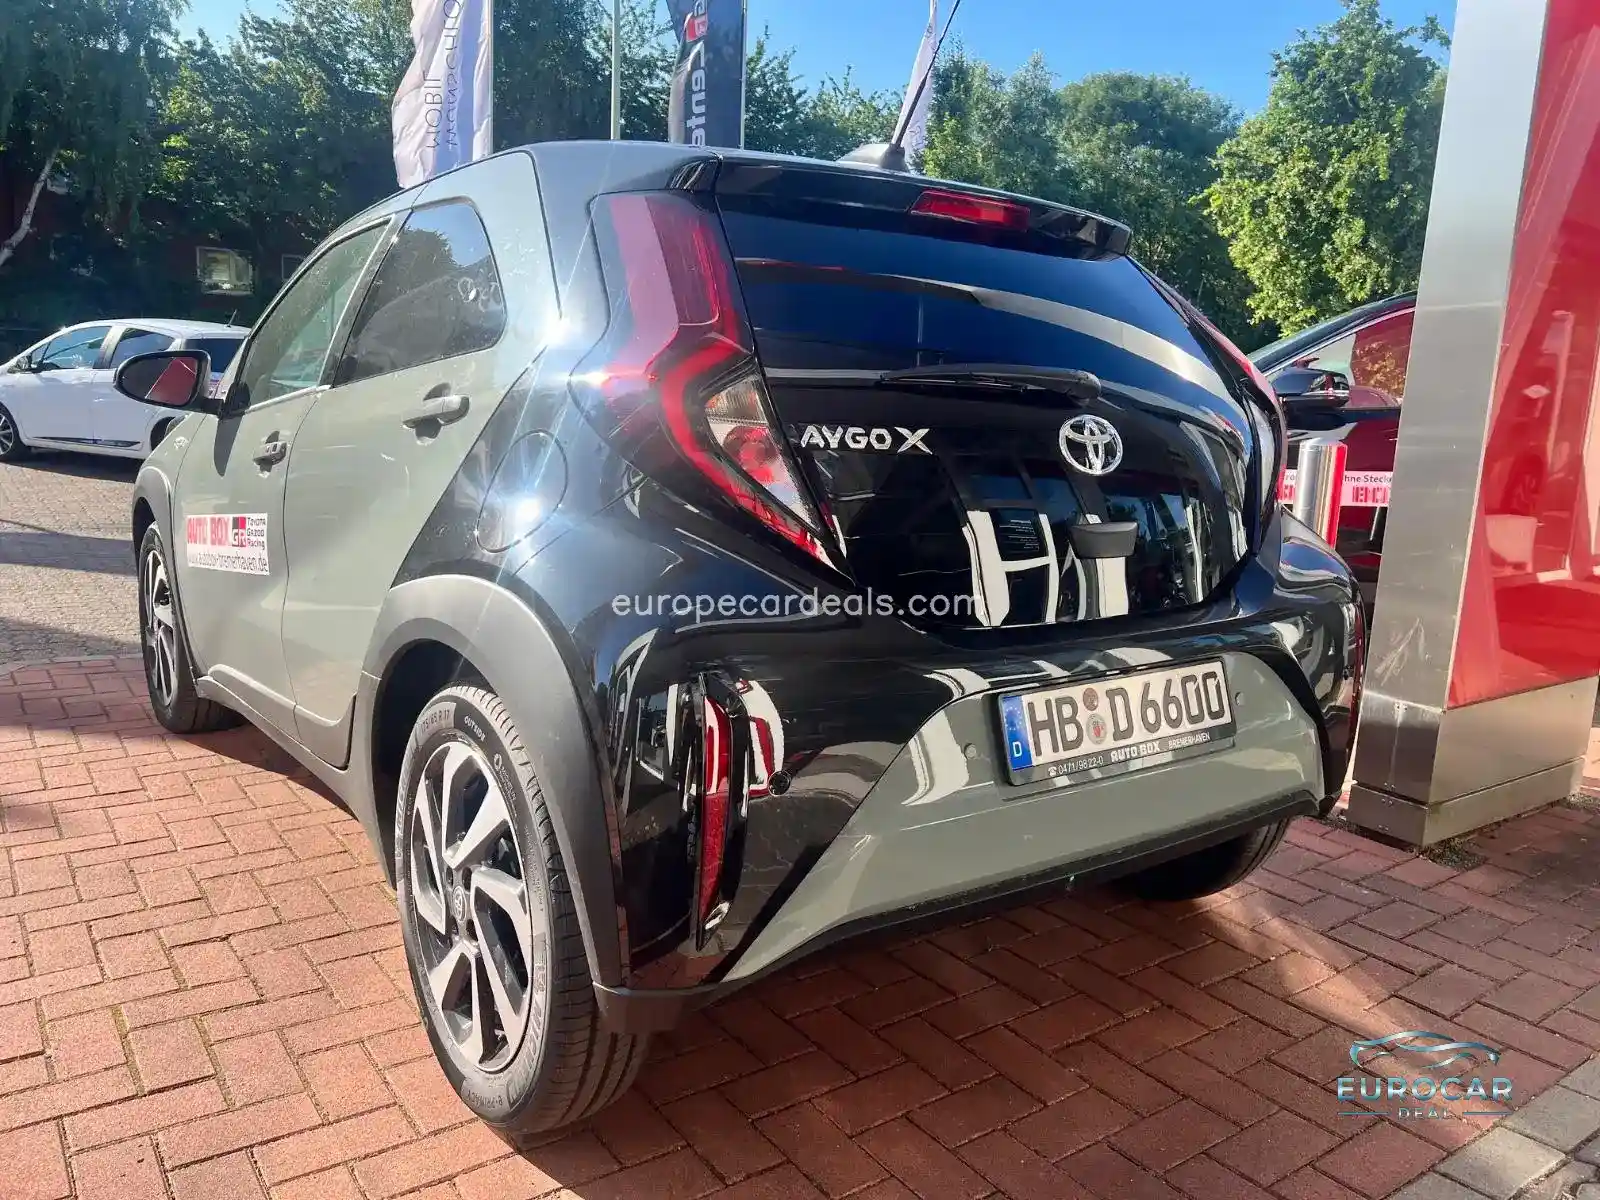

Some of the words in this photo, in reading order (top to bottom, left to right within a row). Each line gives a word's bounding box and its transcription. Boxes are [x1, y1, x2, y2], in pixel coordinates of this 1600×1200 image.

[800, 425, 892, 450] AYGO
[894, 426, 933, 455] X
[210, 516, 231, 546] BOX
[463, 715, 486, 742] OUTSIDE
[1027, 695, 1084, 758] HB
[1140, 671, 1225, 734] 6600
[1013, 741, 1022, 757] D
[1110, 746, 1138, 763] AUTO
[1139, 741, 1161, 756] BOX
[1168, 732, 1211, 750] BREMERHAVEN
